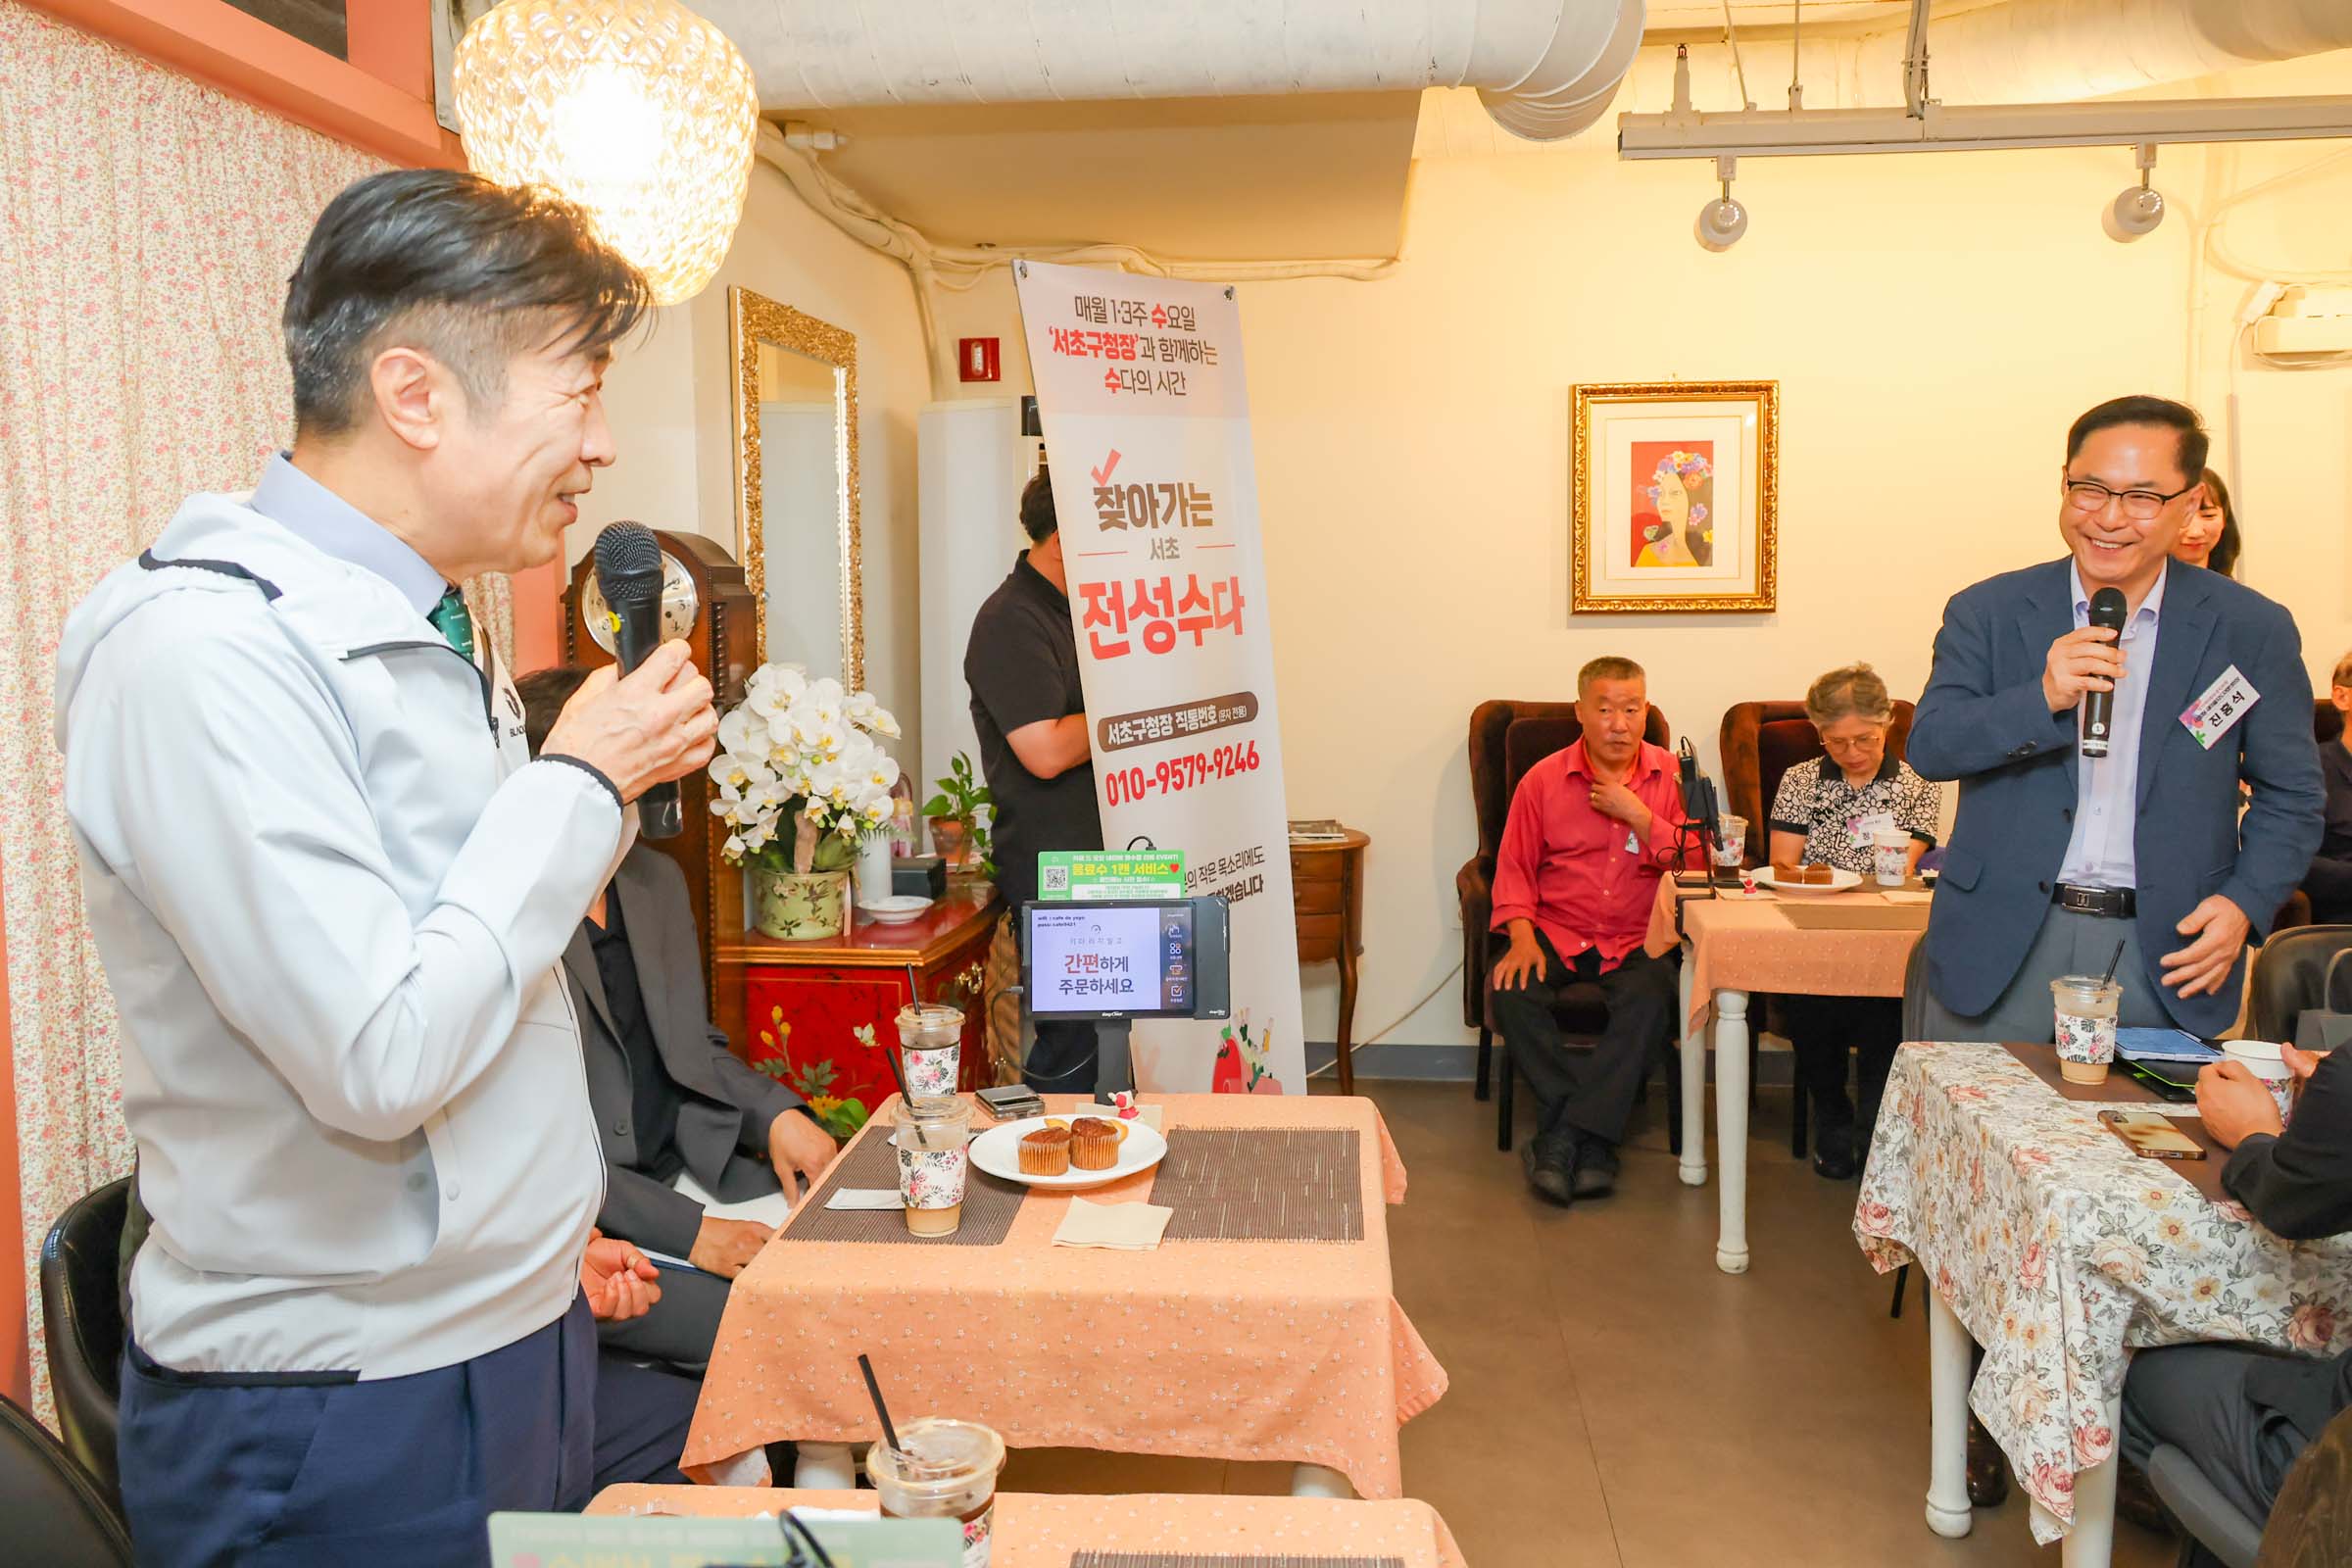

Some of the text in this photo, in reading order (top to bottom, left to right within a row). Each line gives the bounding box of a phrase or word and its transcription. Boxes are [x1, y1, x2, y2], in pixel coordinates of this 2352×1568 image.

[1074, 296, 1108, 324] 매월
[1151, 303, 1197, 332] 수요일
[1157, 337, 1218, 366] 함께하는
[1104, 368, 1187, 396] 수다의 시간
[1093, 480, 1214, 532] 찾아가는
[1150, 536, 1180, 561] 서초
[1078, 573, 1246, 661] 전성수다
[1107, 712, 1173, 746] 서초구청장
[1175, 705, 1218, 732] 직통번호
[1105, 740, 1260, 808] 010-9579-9246
[1072, 863, 1108, 876] 음료수
[1133, 862, 1168, 875] 서비스
[1199, 861, 1217, 885] 작은
[1218, 845, 1265, 876] 목소리에도
[1064, 953, 1129, 974] 간편하게
[1058, 978, 1135, 996] 주문하세요
